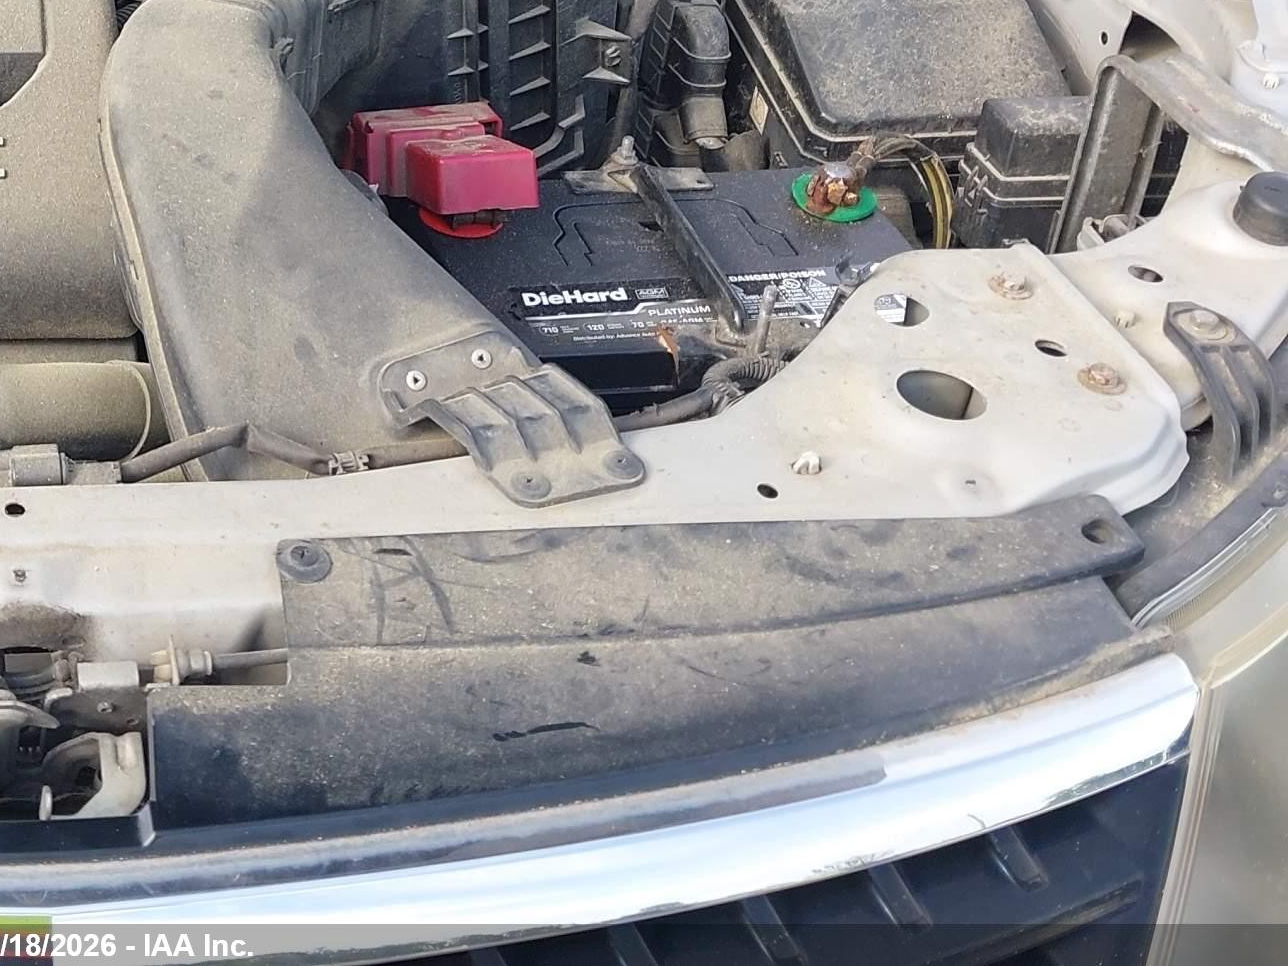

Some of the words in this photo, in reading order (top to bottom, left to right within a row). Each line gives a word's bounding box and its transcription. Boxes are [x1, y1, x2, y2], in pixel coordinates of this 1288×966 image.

[729, 270, 827, 283] DANGER/POISON
[521, 287, 629, 306] DieHard
[647, 305, 712, 316] PLATINUM
